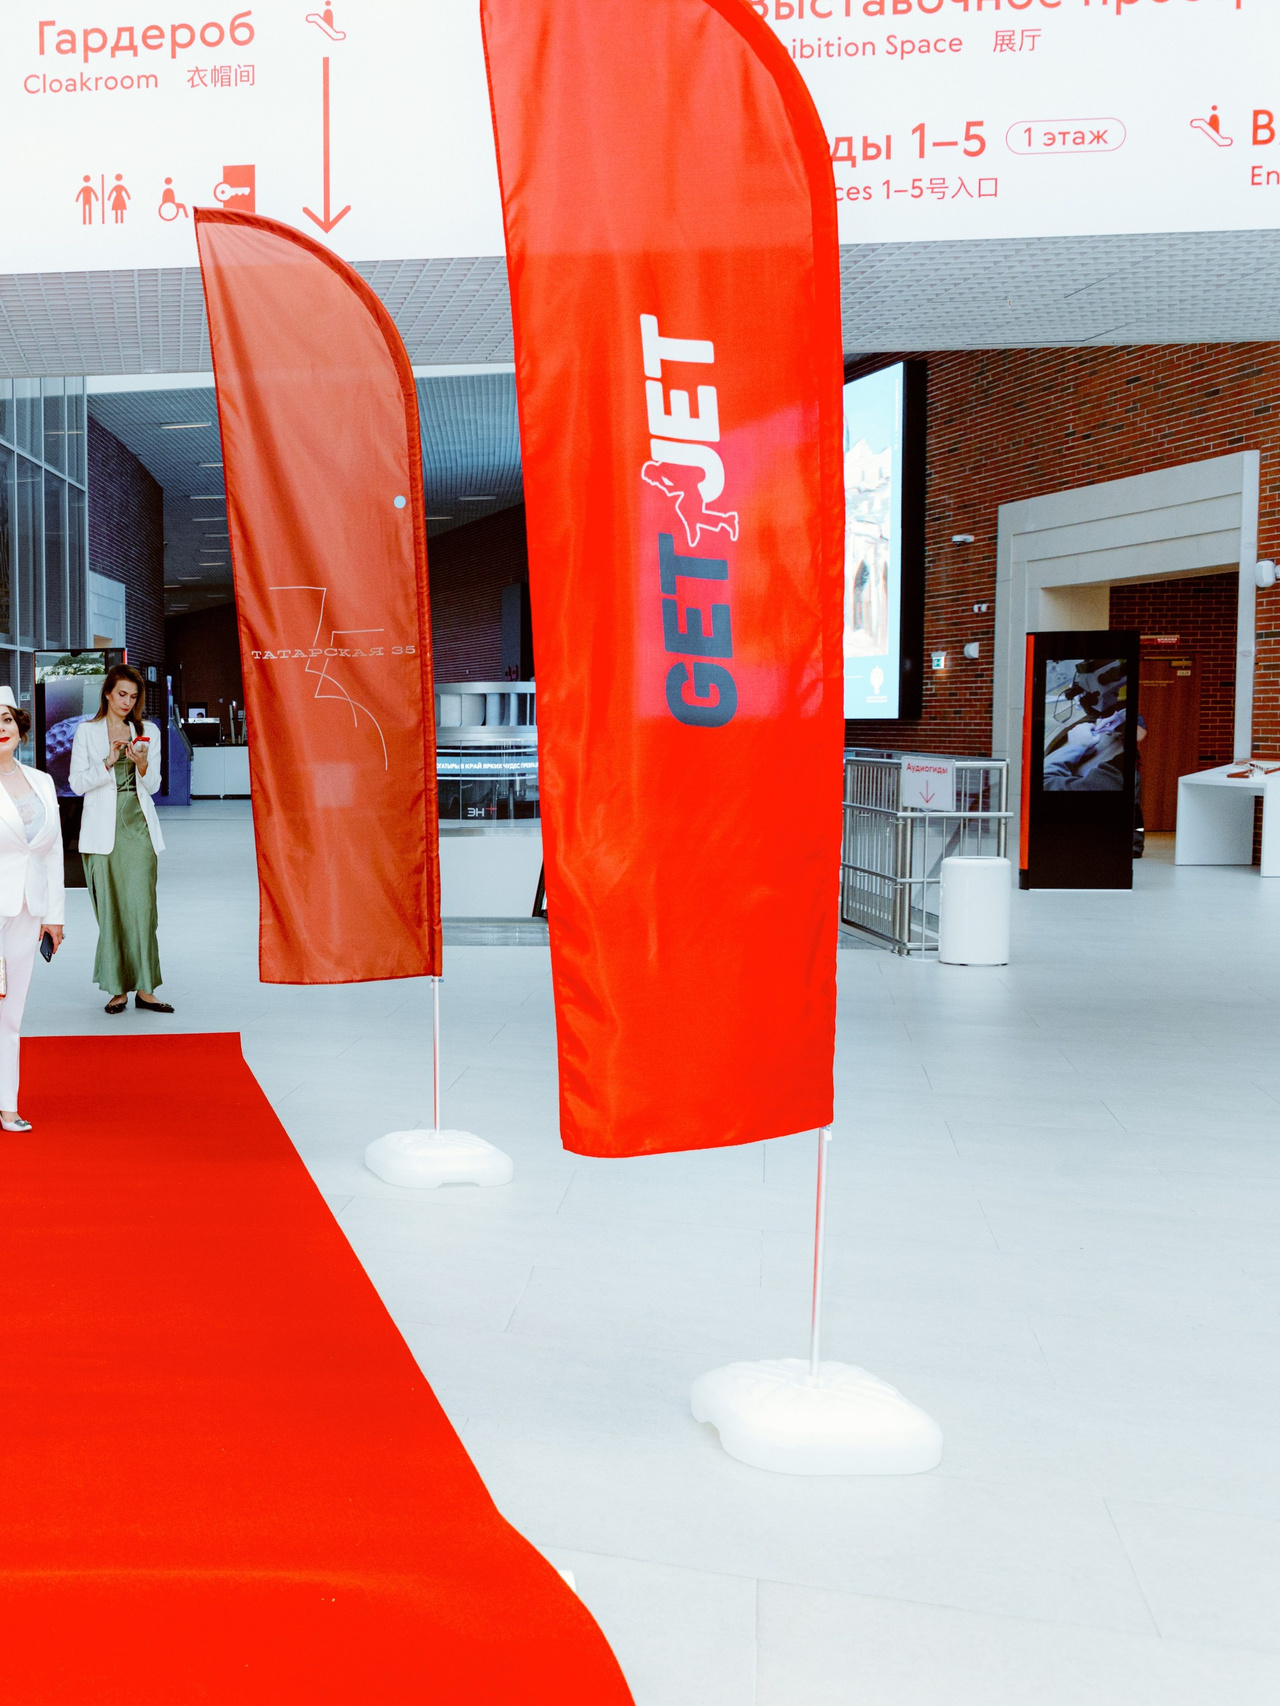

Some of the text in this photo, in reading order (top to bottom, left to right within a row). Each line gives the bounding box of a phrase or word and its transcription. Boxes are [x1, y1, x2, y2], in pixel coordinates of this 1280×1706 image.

[757, 0, 1062, 20] ыставо
[37, 10, 255, 63] Гардероб
[786, 34, 963, 60] ibition Space
[993, 28, 1042, 52] 展厅
[23, 72, 159, 94] Cloakroom
[186, 64, 255, 88] 衣帽间
[1023, 127, 1109, 147] 1 этаж
[1252, 109, 1280, 146] В
[640, 313, 738, 729] GET JET
[251, 645, 416, 660] ТАТАРСКАЯ 35
[907, 763, 948, 774] Аудиогиды
